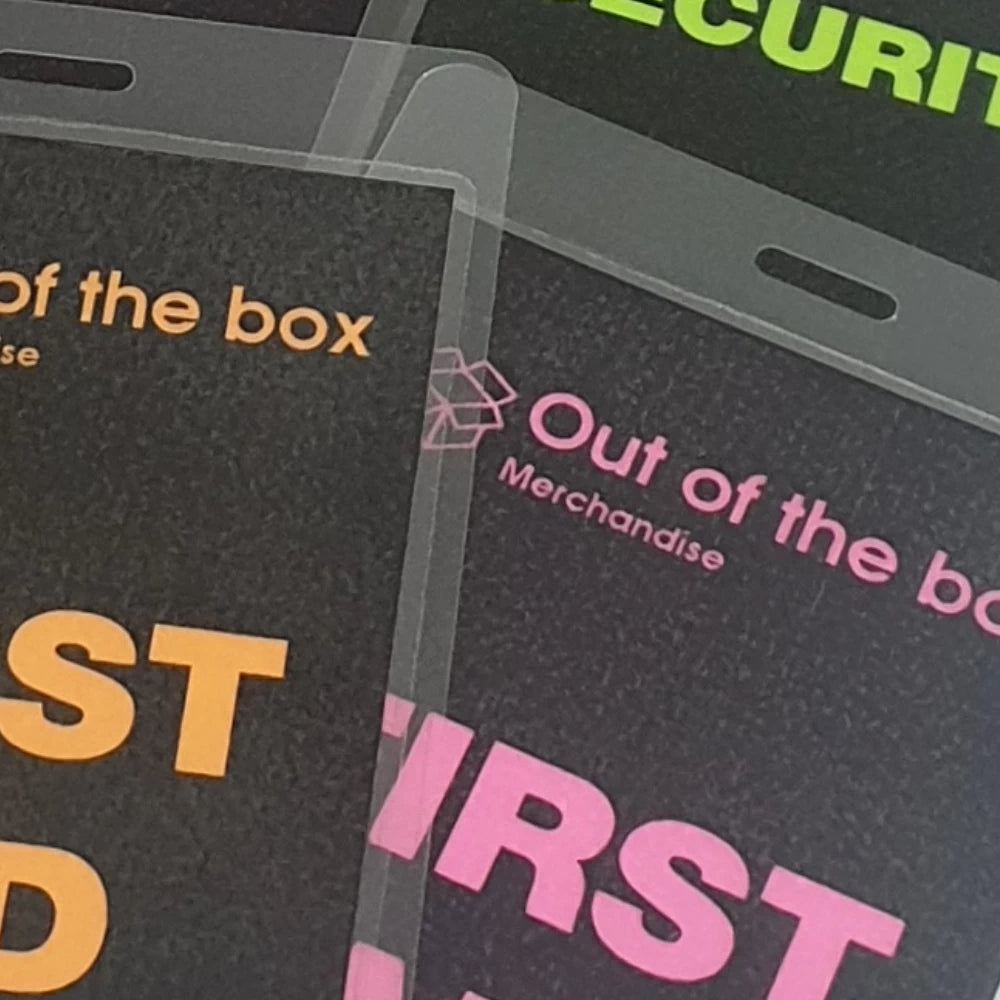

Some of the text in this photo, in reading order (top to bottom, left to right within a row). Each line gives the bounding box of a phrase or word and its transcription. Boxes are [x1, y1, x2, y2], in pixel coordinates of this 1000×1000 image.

[79, 269, 200, 336] the
[223, 284, 374, 361] box
[499, 455, 725, 572] Merchandise
[528, 392, 668, 488] Out
[681, 471, 767, 525] of
[773, 492, 898, 585] the
